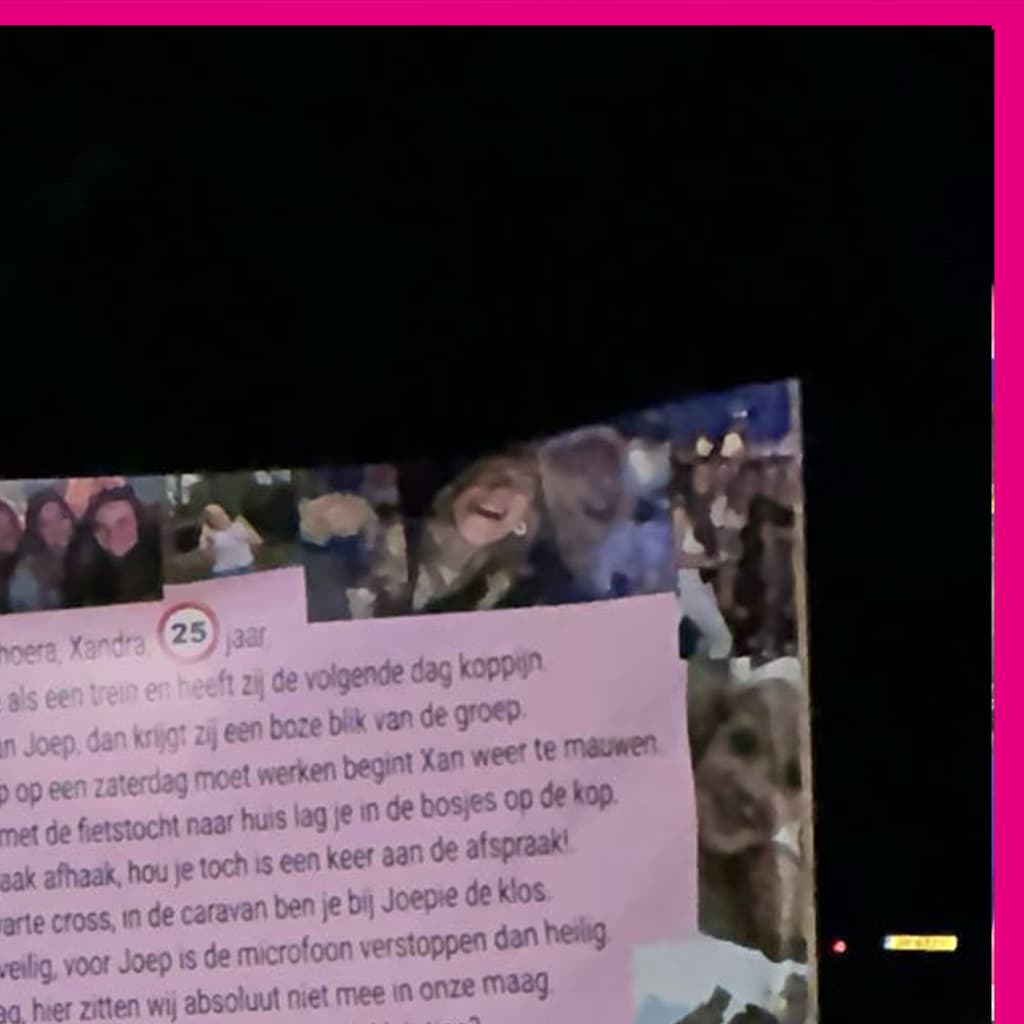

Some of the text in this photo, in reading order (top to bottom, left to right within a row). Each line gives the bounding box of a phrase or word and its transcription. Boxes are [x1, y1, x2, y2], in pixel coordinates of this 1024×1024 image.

[171, 620, 207, 646] 25
[9, 685, 38, 713] als
[46, 688, 83, 709] een
[90, 684, 138, 706] trein
[144, 682, 170, 702] en
[176, 669, 234, 699] heeft
[241, 669, 264, 702] zij
[272, 667, 297, 693] de
[305, 659, 402, 696] volgende
[410, 656, 452, 689] dag
[87, 727, 127, 753] dan
[133, 724, 187, 754] krijgt
[194, 725, 218, 752] zij
[225, 721, 263, 744] een
[269, 712, 322, 740] boze
[329, 707, 367, 736] blik
[374, 710, 413, 732] van
[420, 701, 447, 729] de
[15, 781, 42, 808] op
[48, 779, 87, 800] een
[94, 768, 188, 800] zaterdag
[195, 764, 251, 792] moet
[257, 758, 337, 786] werken
[342, 752, 413, 785] begint
[421, 747, 465, 773] Xan
[471, 743, 528, 768] weer
[533, 738, 558, 762] te
[45, 818, 71, 846] de
[77, 813, 178, 843] fietstocht
[185, 814, 232, 836] naar
[240, 806, 287, 832] huis
[293, 802, 326, 834] lag
[332, 803, 352, 832] je
[359, 802, 379, 823] in
[385, 794, 413, 822] de
[420, 791, 496, 822] bosjes
[503, 789, 532, 816] op
[539, 781, 566, 809] de
[43, 860, 122, 890] afhaak,
[127, 859, 168, 884] hou
[173, 861, 193, 888] je
[199, 850, 247, 880] toch
[254, 855, 273, 876] is
[279, 852, 320, 875] een
[327, 844, 373, 870] keer
[381, 844, 422, 868] aan
[429, 836, 458, 863] de
[52, 910, 115, 934] cross,
[121, 908, 141, 929] in
[147, 901, 174, 928] de
[179, 900, 267, 926] caravan
[273, 893, 315, 920] ben
[321, 891, 341, 924] je
[347, 888, 374, 920] bij
[380, 886, 457, 915] Joepie
[463, 878, 491, 907] de
[62, 955, 109, 977] voor
[116, 948, 172, 978] Joep
[178, 949, 196, 970] is
[203, 941, 229, 970] de
[236, 935, 352, 967] microfoon
[359, 931, 486, 961] verstoppen
[494, 924, 539, 951] dan
[33, 997, 73, 1023] hier
[78, 996, 140, 1021] zitten
[145, 997, 177, 1023] wij
[183, 985, 280, 1015] absoluut
[287, 984, 328, 1010] niet
[334, 985, 385, 1006] mee
[392, 982, 412, 1003] in
[418, 977, 474, 1002] onze
